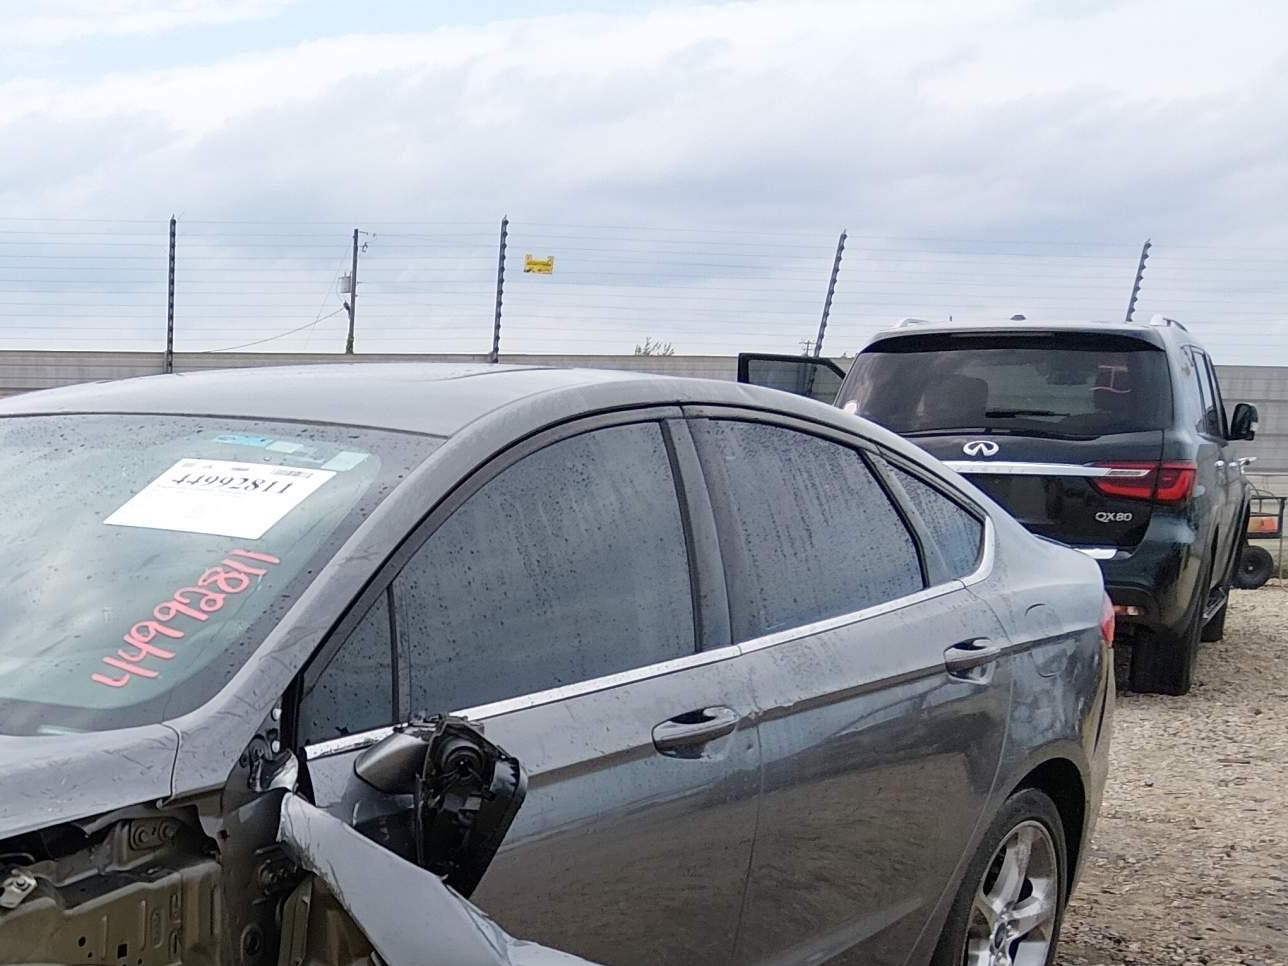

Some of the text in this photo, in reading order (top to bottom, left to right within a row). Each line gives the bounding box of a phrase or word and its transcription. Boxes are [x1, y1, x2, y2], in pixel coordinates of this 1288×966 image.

[171, 473, 294, 494] 44992811
[1095, 511, 1133, 523] QX80
[91, 549, 280, 687] 44992811
